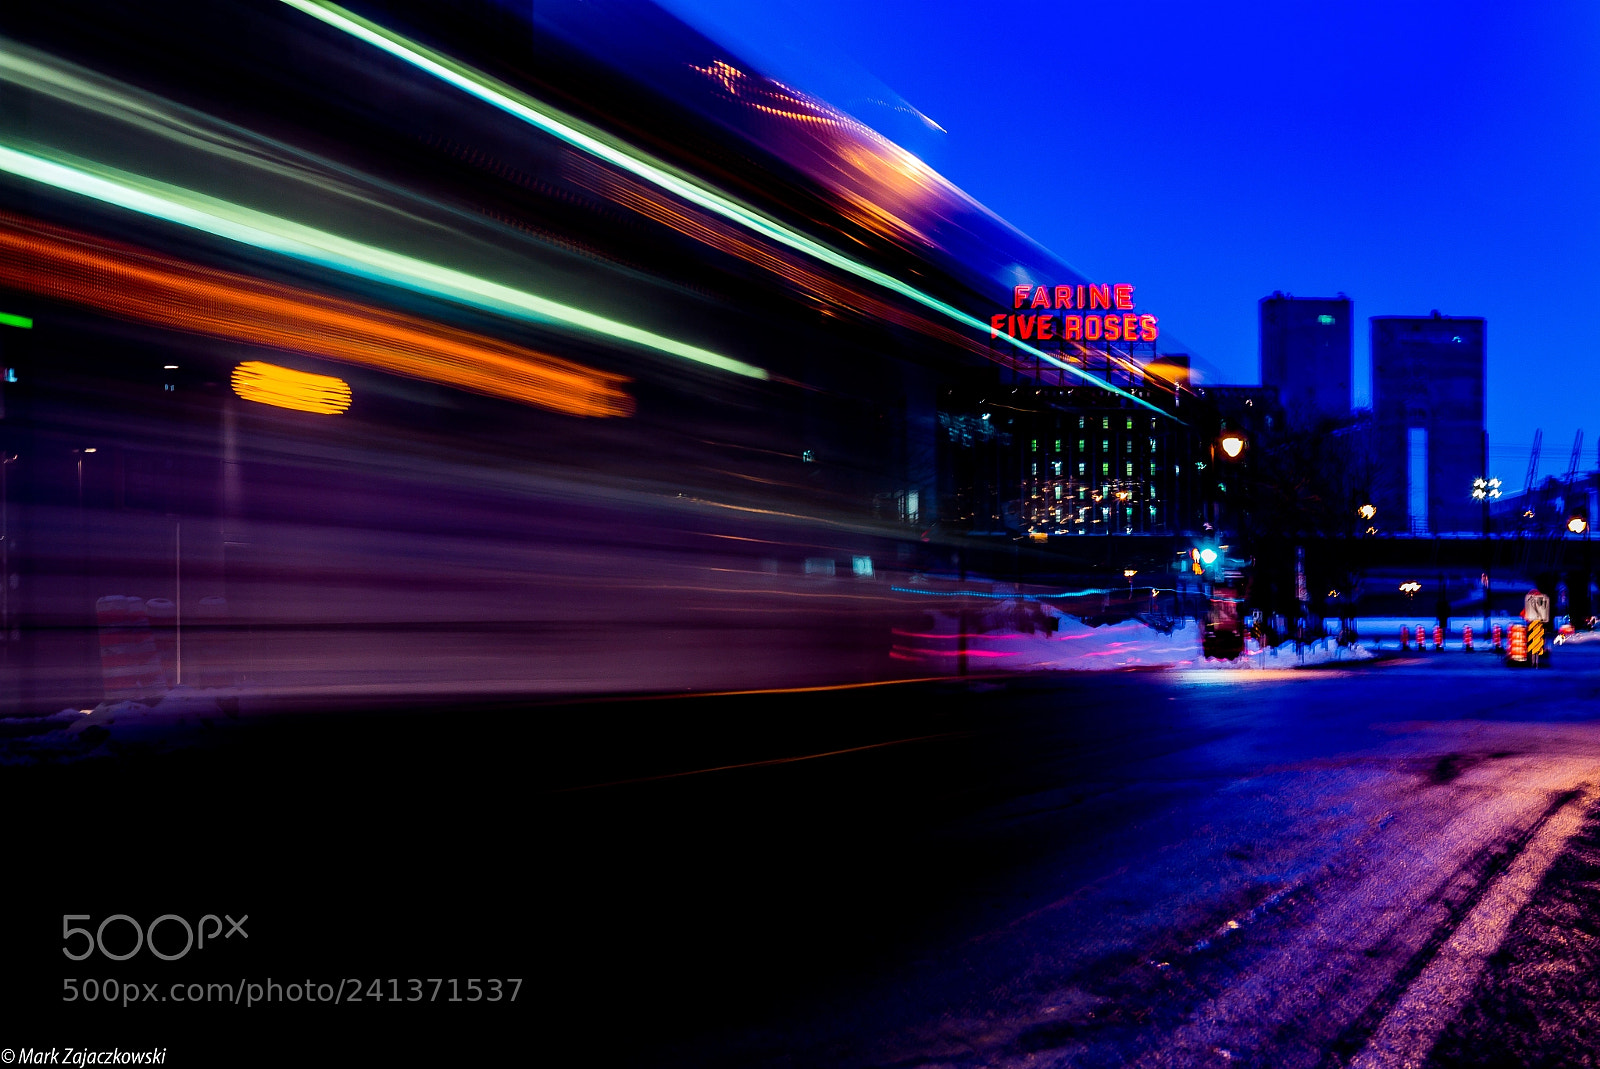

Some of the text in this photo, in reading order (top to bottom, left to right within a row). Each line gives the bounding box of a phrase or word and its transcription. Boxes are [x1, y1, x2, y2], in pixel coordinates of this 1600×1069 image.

[1014, 284, 1135, 311] FARINE
[991, 313, 1160, 342] FIVE ROSES
